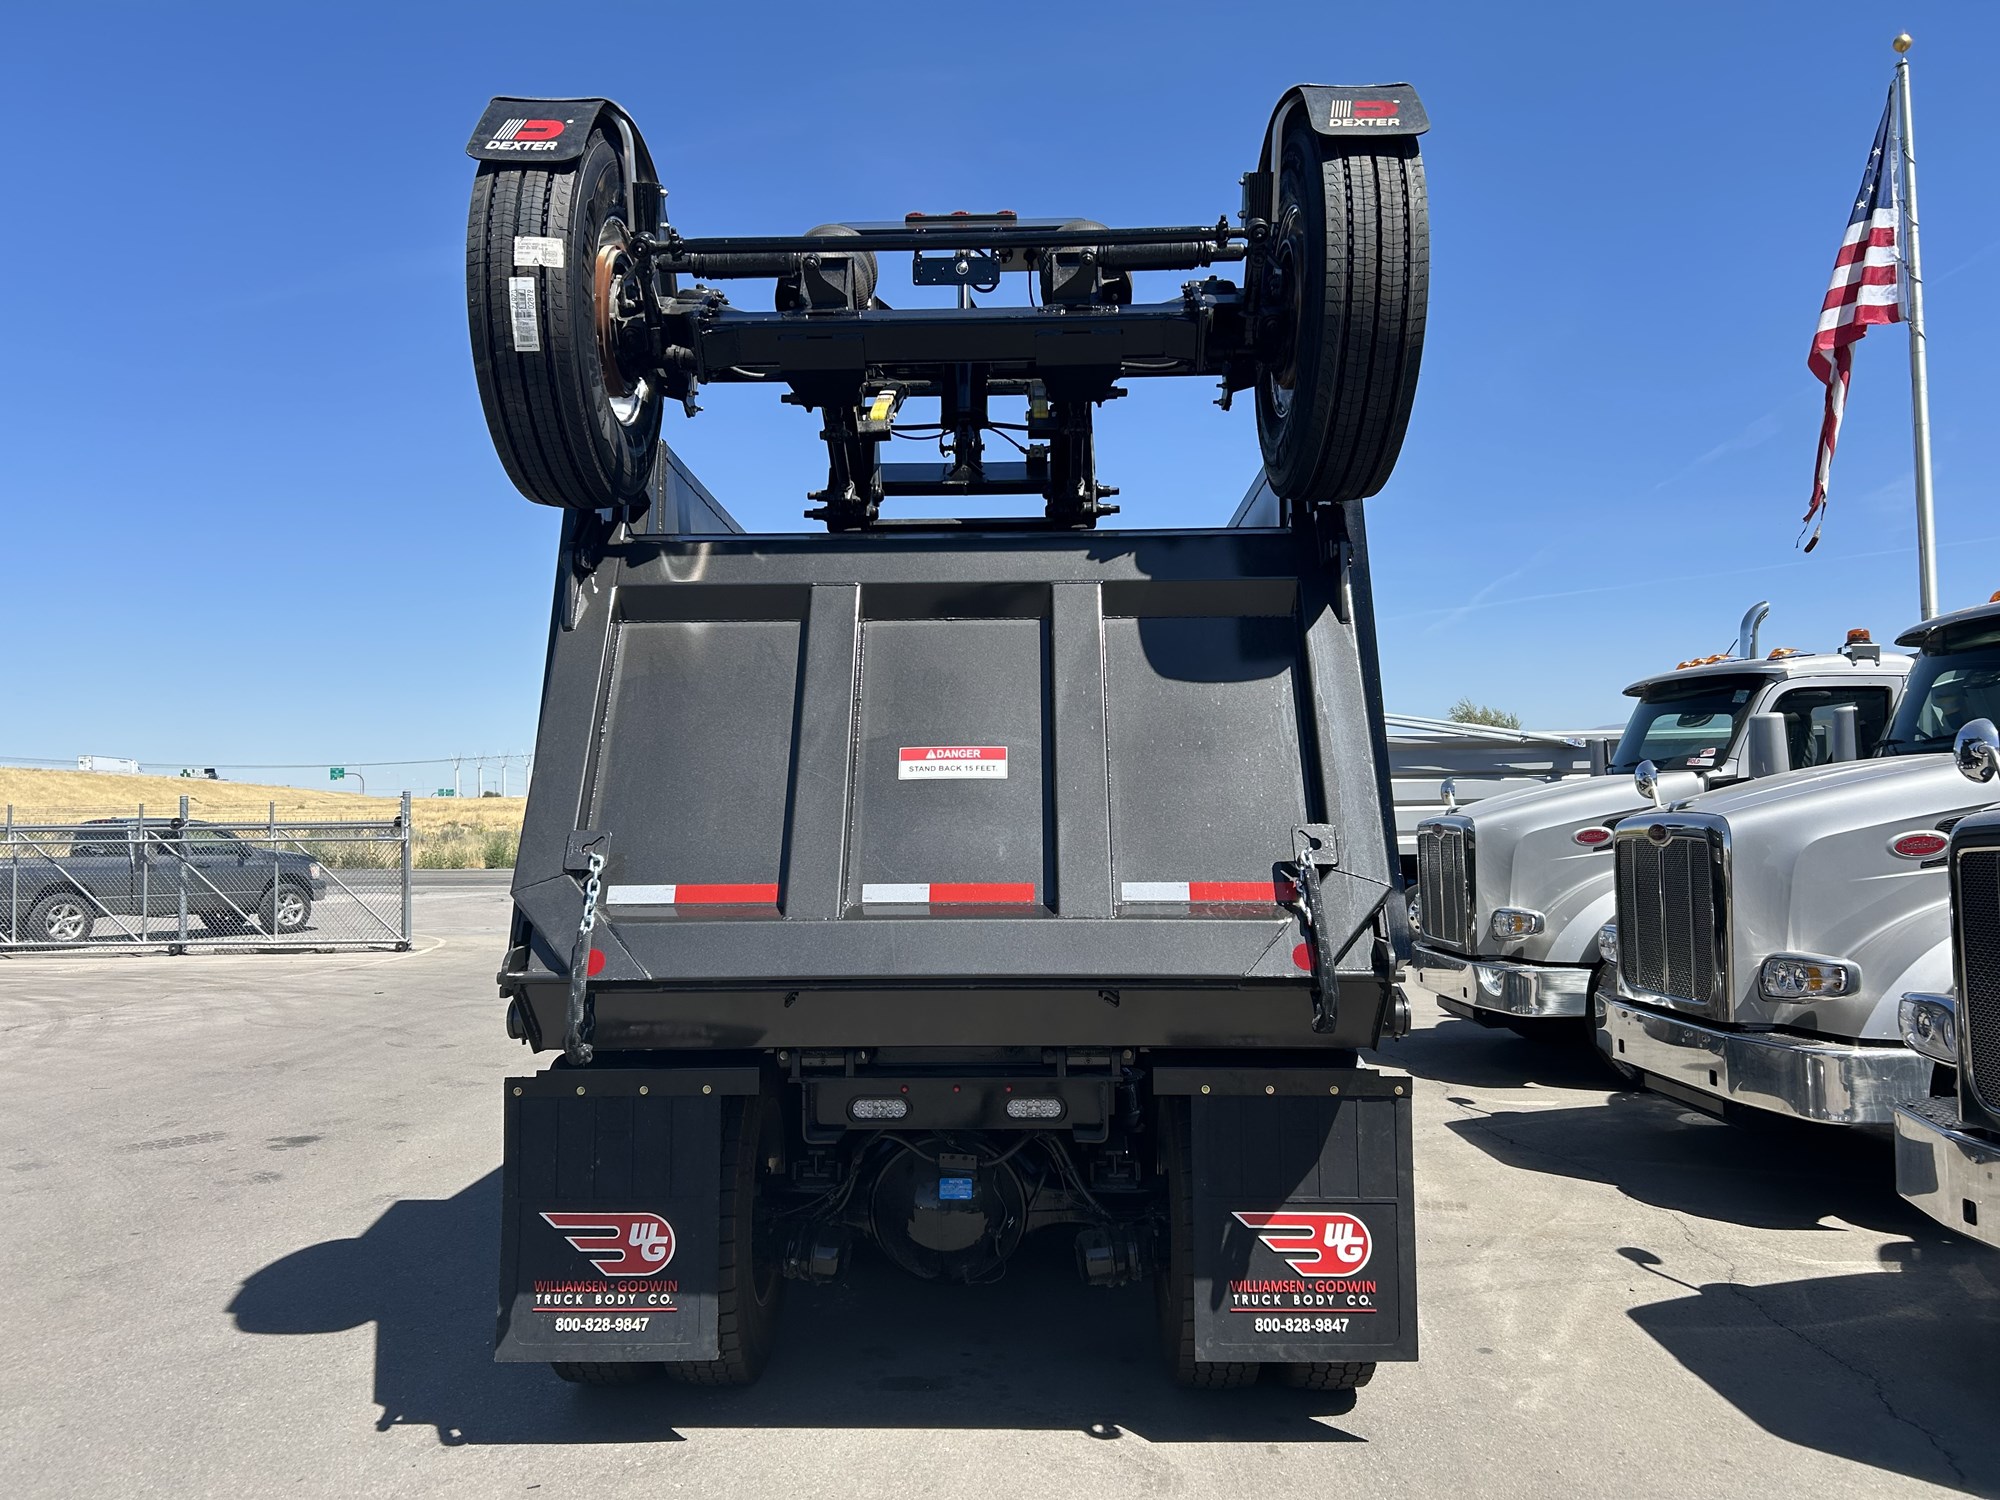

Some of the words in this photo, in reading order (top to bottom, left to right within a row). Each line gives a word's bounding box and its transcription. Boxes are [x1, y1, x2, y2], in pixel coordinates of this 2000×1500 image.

[1329, 118, 1400, 127] DEXTER
[485, 140, 558, 151] DEXTER
[936, 749, 981, 759] DANGER
[534, 1280, 607, 1293] WILLIAMSEN
[617, 1280, 678, 1293] GODWIN
[1230, 1280, 1305, 1293] WILLIAMSEN
[1315, 1280, 1376, 1293] GODWIN
[535, 1294, 583, 1305] TRUCK
[595, 1294, 636, 1305] BODY
[648, 1294, 673, 1305] CO.
[1233, 1294, 1281, 1305] TRUCK
[1293, 1294, 1334, 1305] BODY
[1346, 1294, 1372, 1305] CO.
[555, 1317, 649, 1332] 800-828-9847
[1255, 1318, 1349, 1332] 800-828-9847
